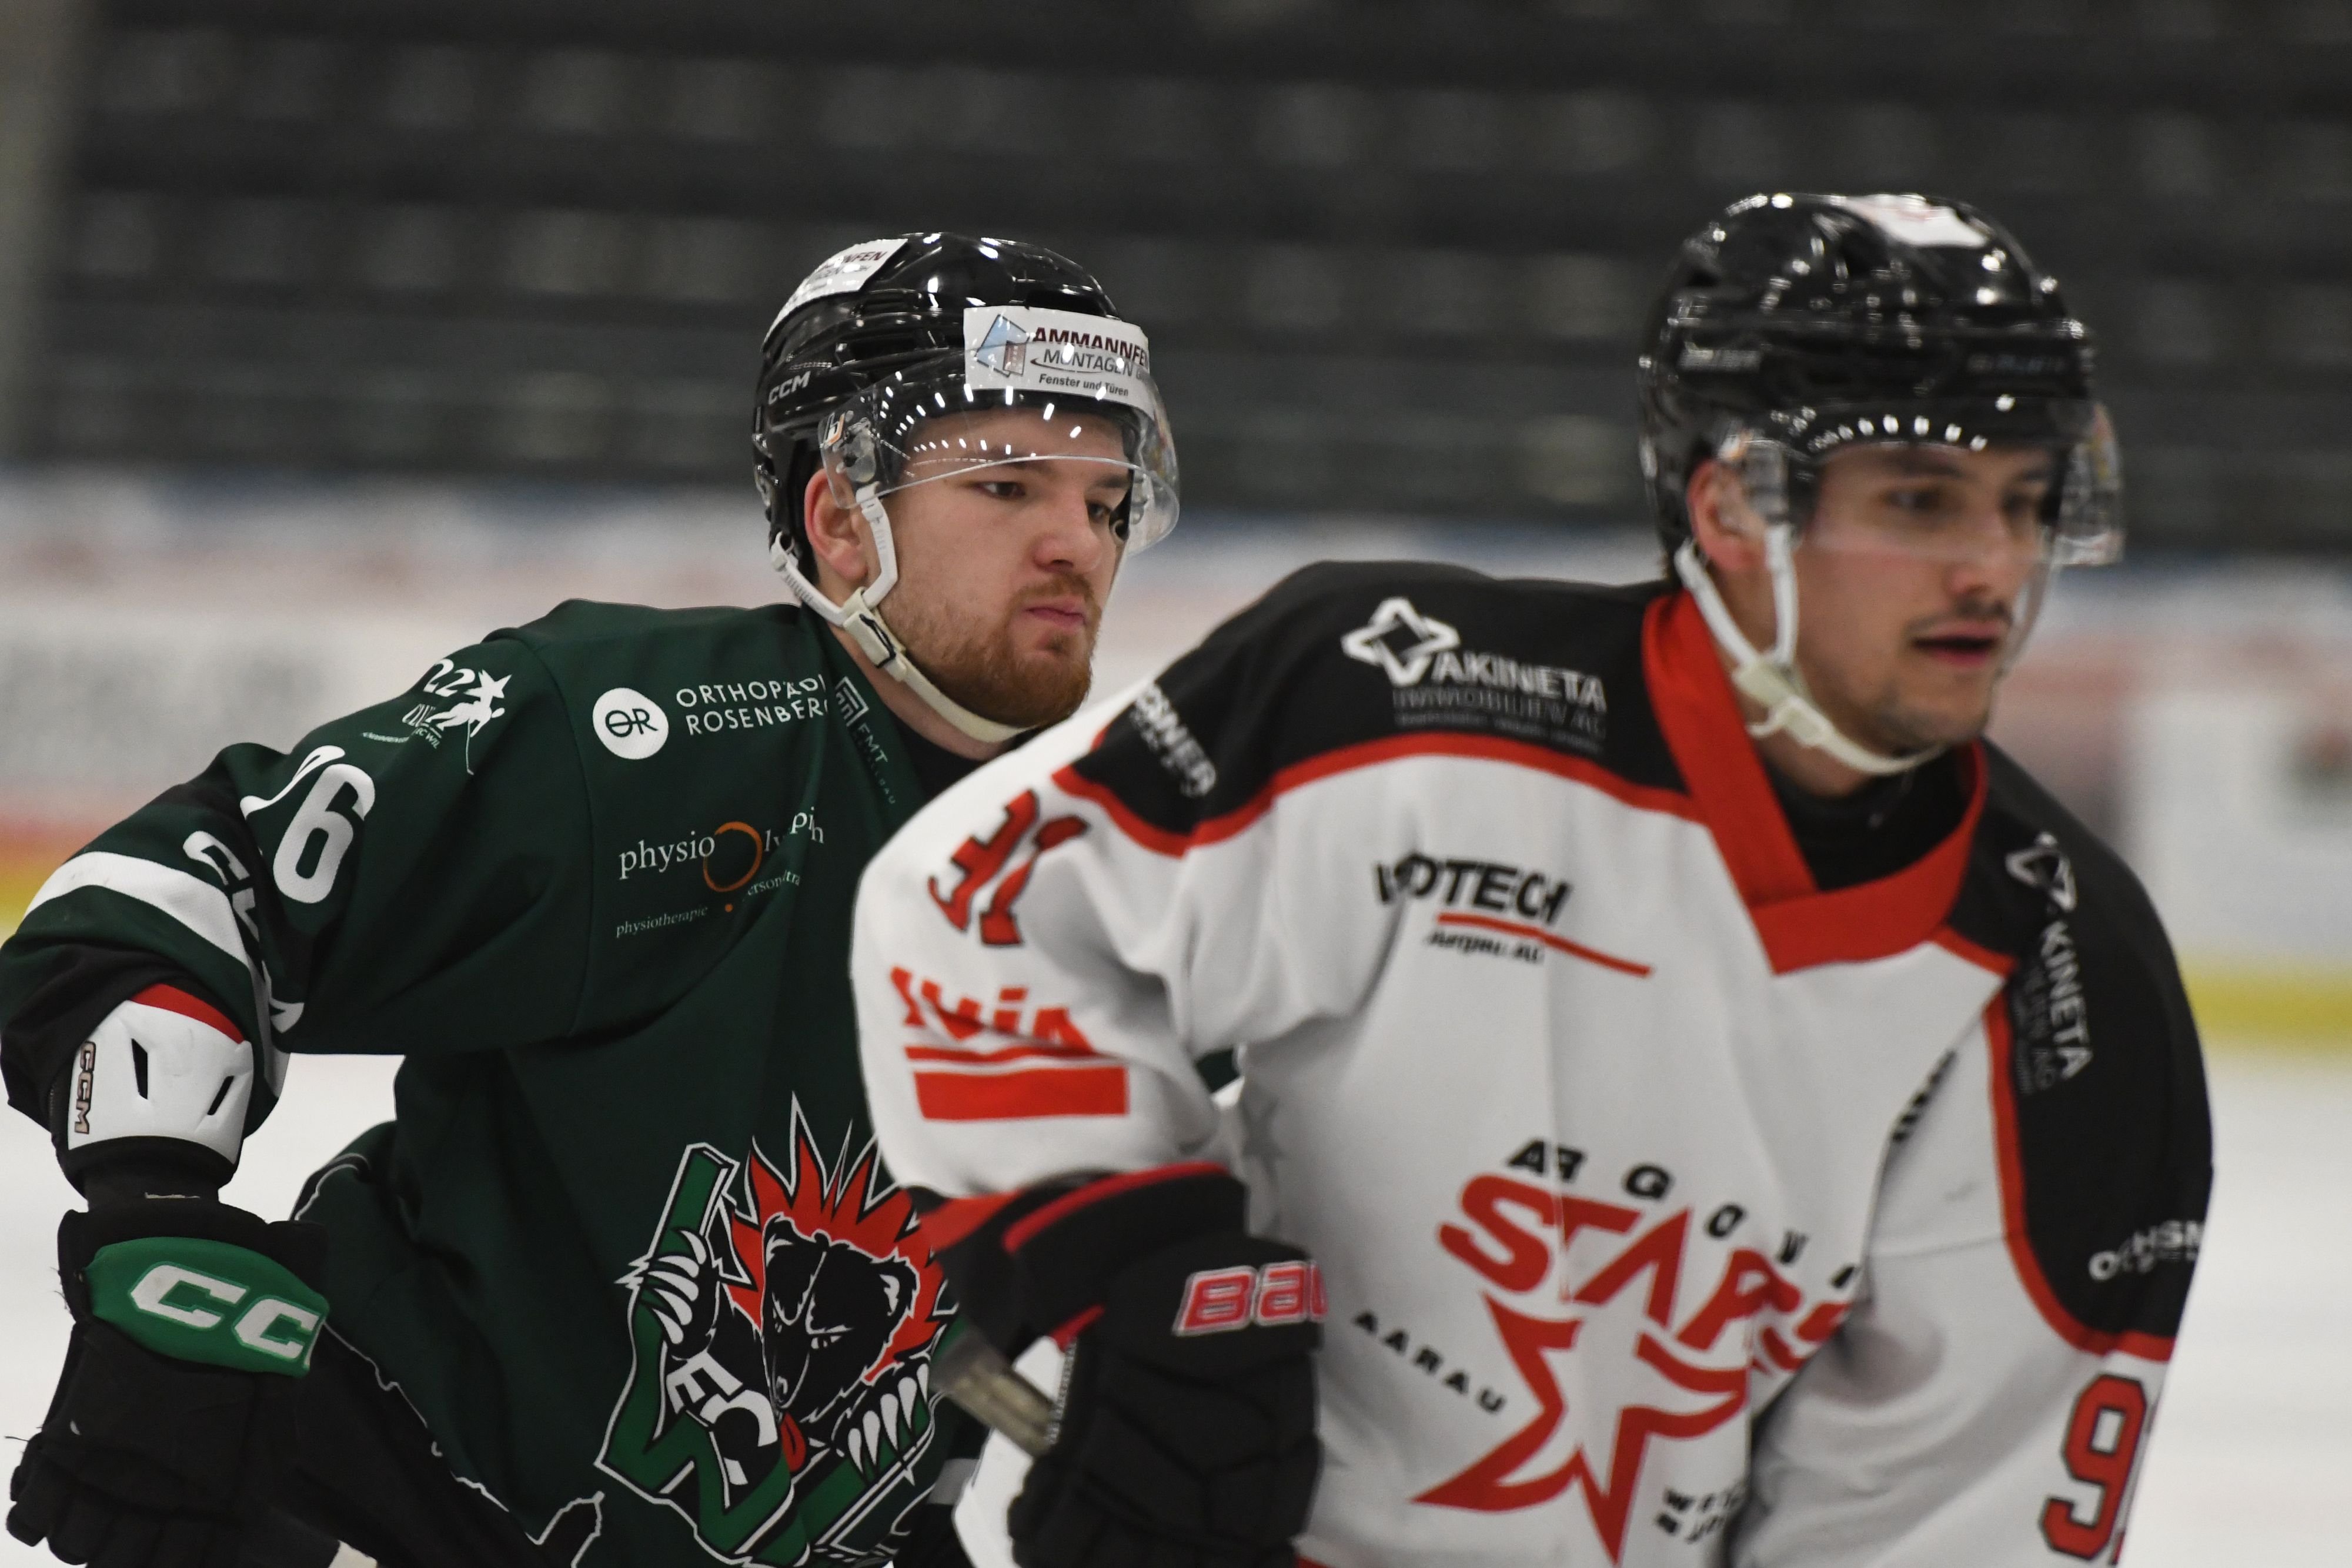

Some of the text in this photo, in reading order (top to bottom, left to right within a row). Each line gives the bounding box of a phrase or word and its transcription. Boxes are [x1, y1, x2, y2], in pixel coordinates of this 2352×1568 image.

[1033, 327, 1149, 367] AMMANNFE
[768, 370, 811, 405] CCM
[1038, 373, 1128, 396] Fenster und Türen
[423, 658, 476, 697] 22
[1430, 649, 1607, 713] AKINETA
[686, 698, 827, 735] ROSENBER
[858, 723, 888, 763] FMT
[240, 745, 376, 904] 6
[619, 830, 716, 880] physio
[75, 1041, 96, 1134] CCM
[1352, 1310, 1507, 1413] AARAU
[2037, 1372, 2150, 1567] 9
